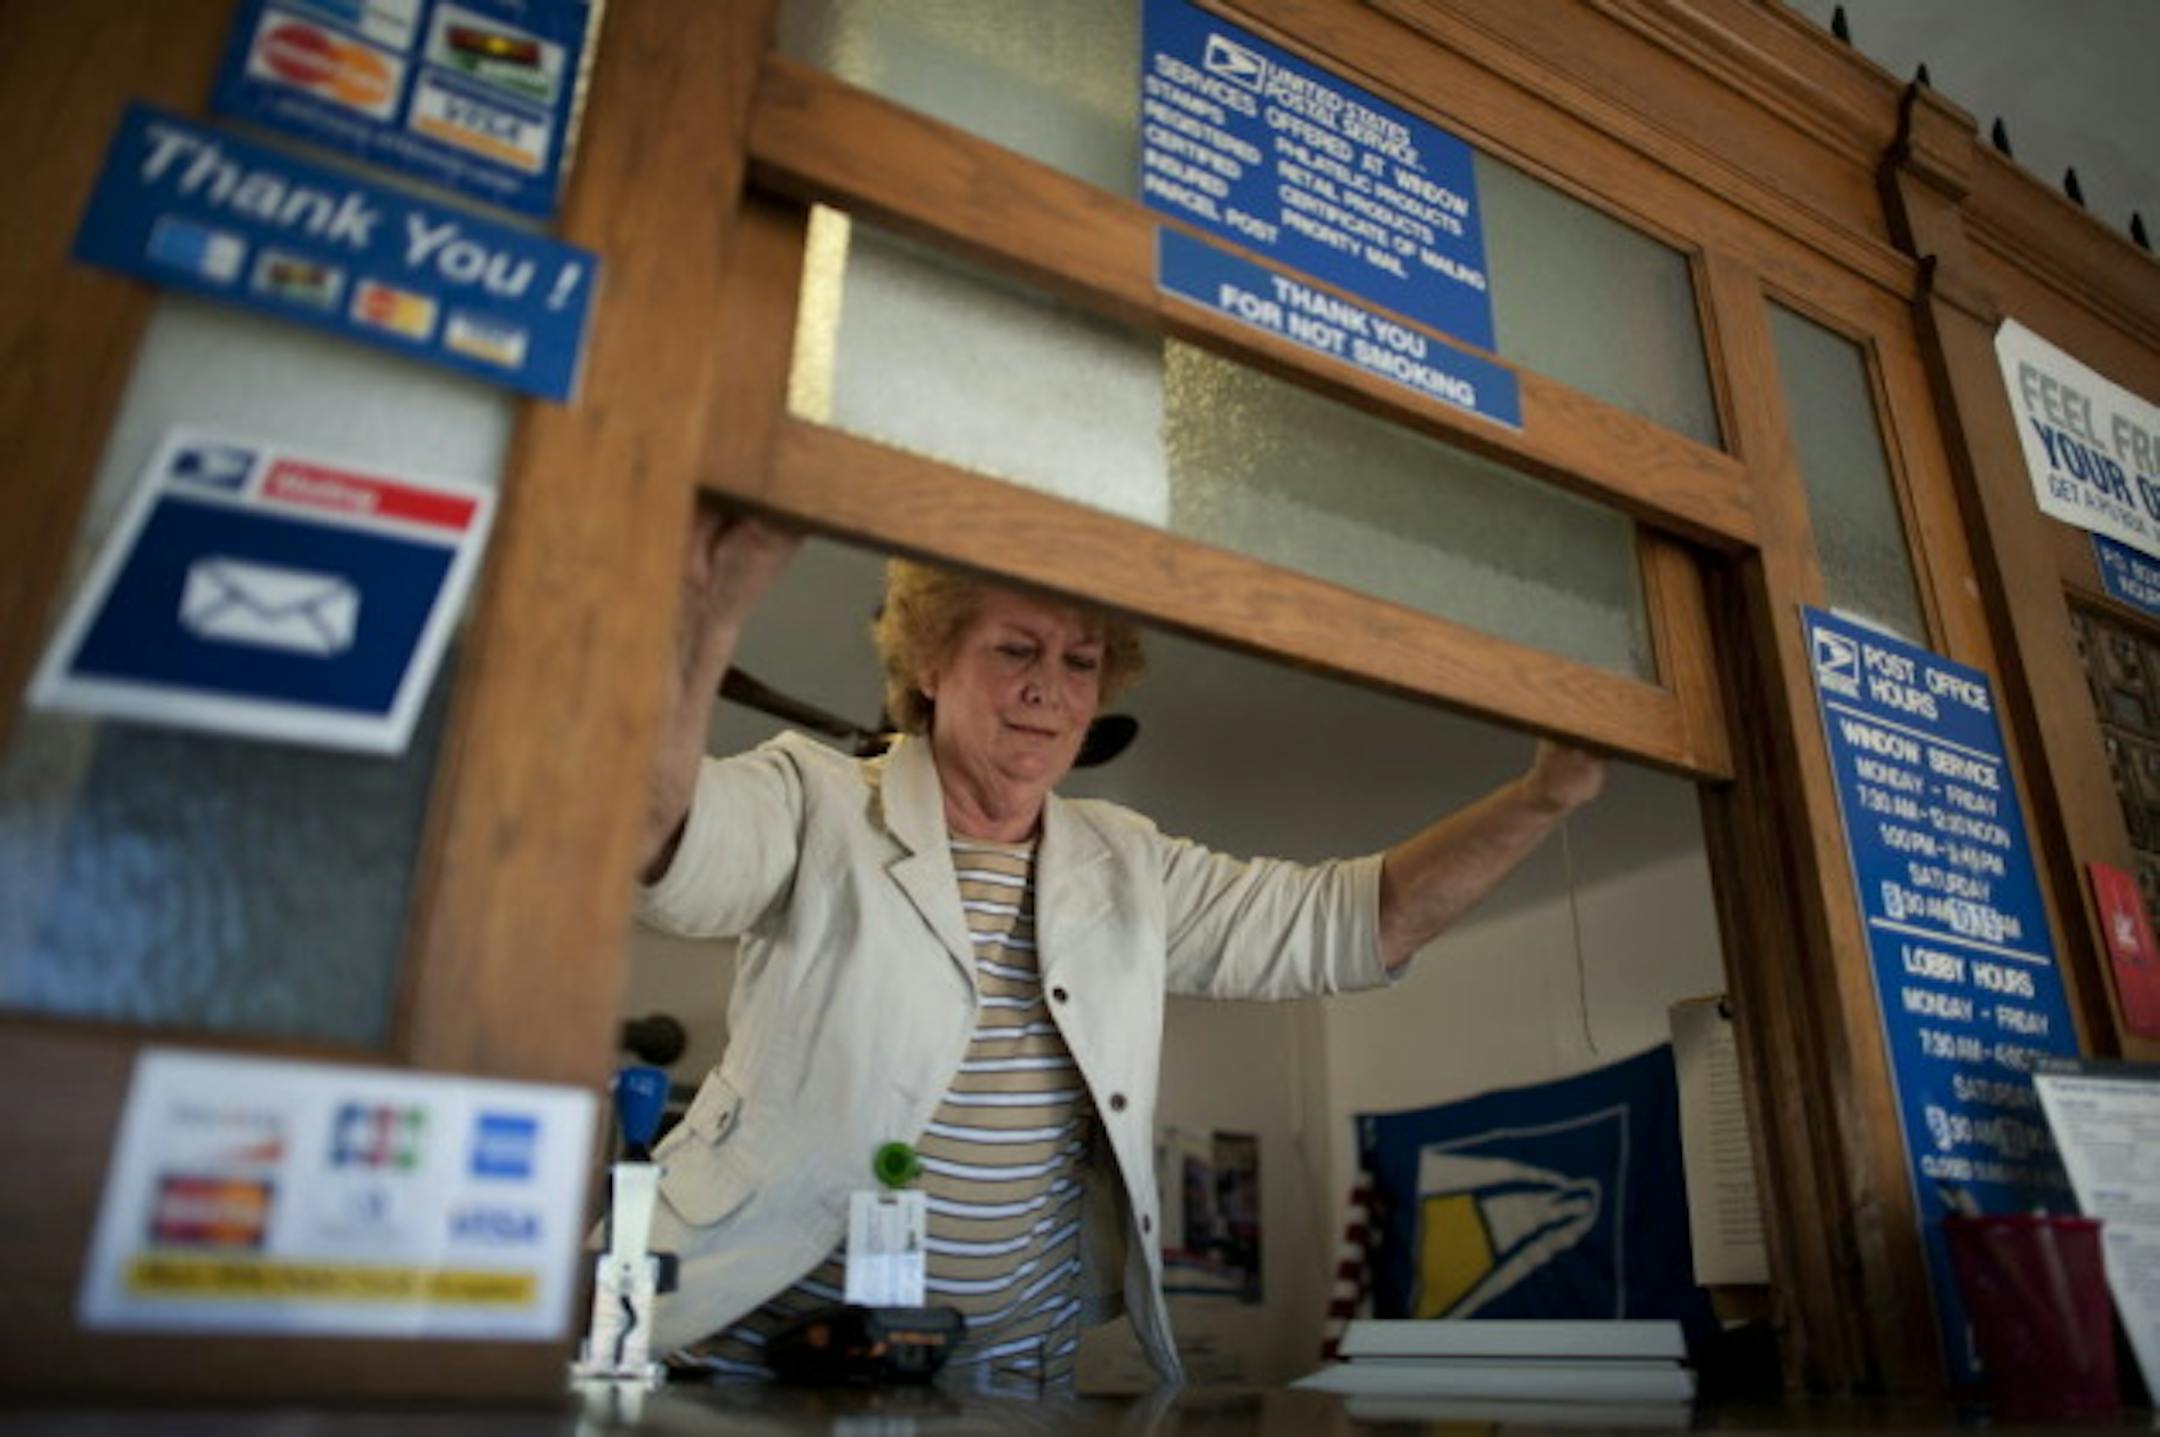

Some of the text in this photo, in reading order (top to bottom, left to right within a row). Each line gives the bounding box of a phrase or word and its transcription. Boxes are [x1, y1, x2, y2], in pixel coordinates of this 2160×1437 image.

[1145, 74, 1226, 125] STAMPS
[1145, 98, 1262, 165] REGISTERED
[1265, 82, 1340, 131] POSTAL
[1269, 62, 1412, 147] UNITED STATES
[1145, 123, 1242, 180] CERTIFIED
[1154, 53, 1469, 217] SERVICES OFFERED AT WINDOW
[1144, 148, 1229, 198] INSURED
[1278, 160, 1435, 245] RETAIL PRODUCTS
[139, 123, 381, 249] Thank
[402, 211, 535, 300] You
[1144, 174, 1279, 244] PARCEL POST
[1279, 183, 1486, 292] CERTIFICATE OF MAILING
[1281, 208, 1361, 256] PRIORITY
[1375, 183, 1463, 236] PRODUCTS
[1218, 283, 1476, 407] FOR NOT SMOKING
[1271, 275, 1427, 359] THANK YOU
[2018, 360, 2105, 450] FEEL
[2029, 417, 2136, 509] YOUR
[1862, 644, 1990, 713] POST OFFICE
[1868, 676, 1938, 720] HOURS
[1841, 718, 2000, 790] WINDOW SERVICE
[1855, 757, 1924, 794] MONDAY
[1946, 786, 1997, 816] FRIDAY
[1909, 861, 1990, 901] SATURDAY
[1902, 944, 2034, 999] LOBBY HOURS
[1902, 987, 1973, 1021] MONDAY
[1995, 1004, 2049, 1035] FRIDAY
[1921, 1154, 1972, 1181] CLOSED
